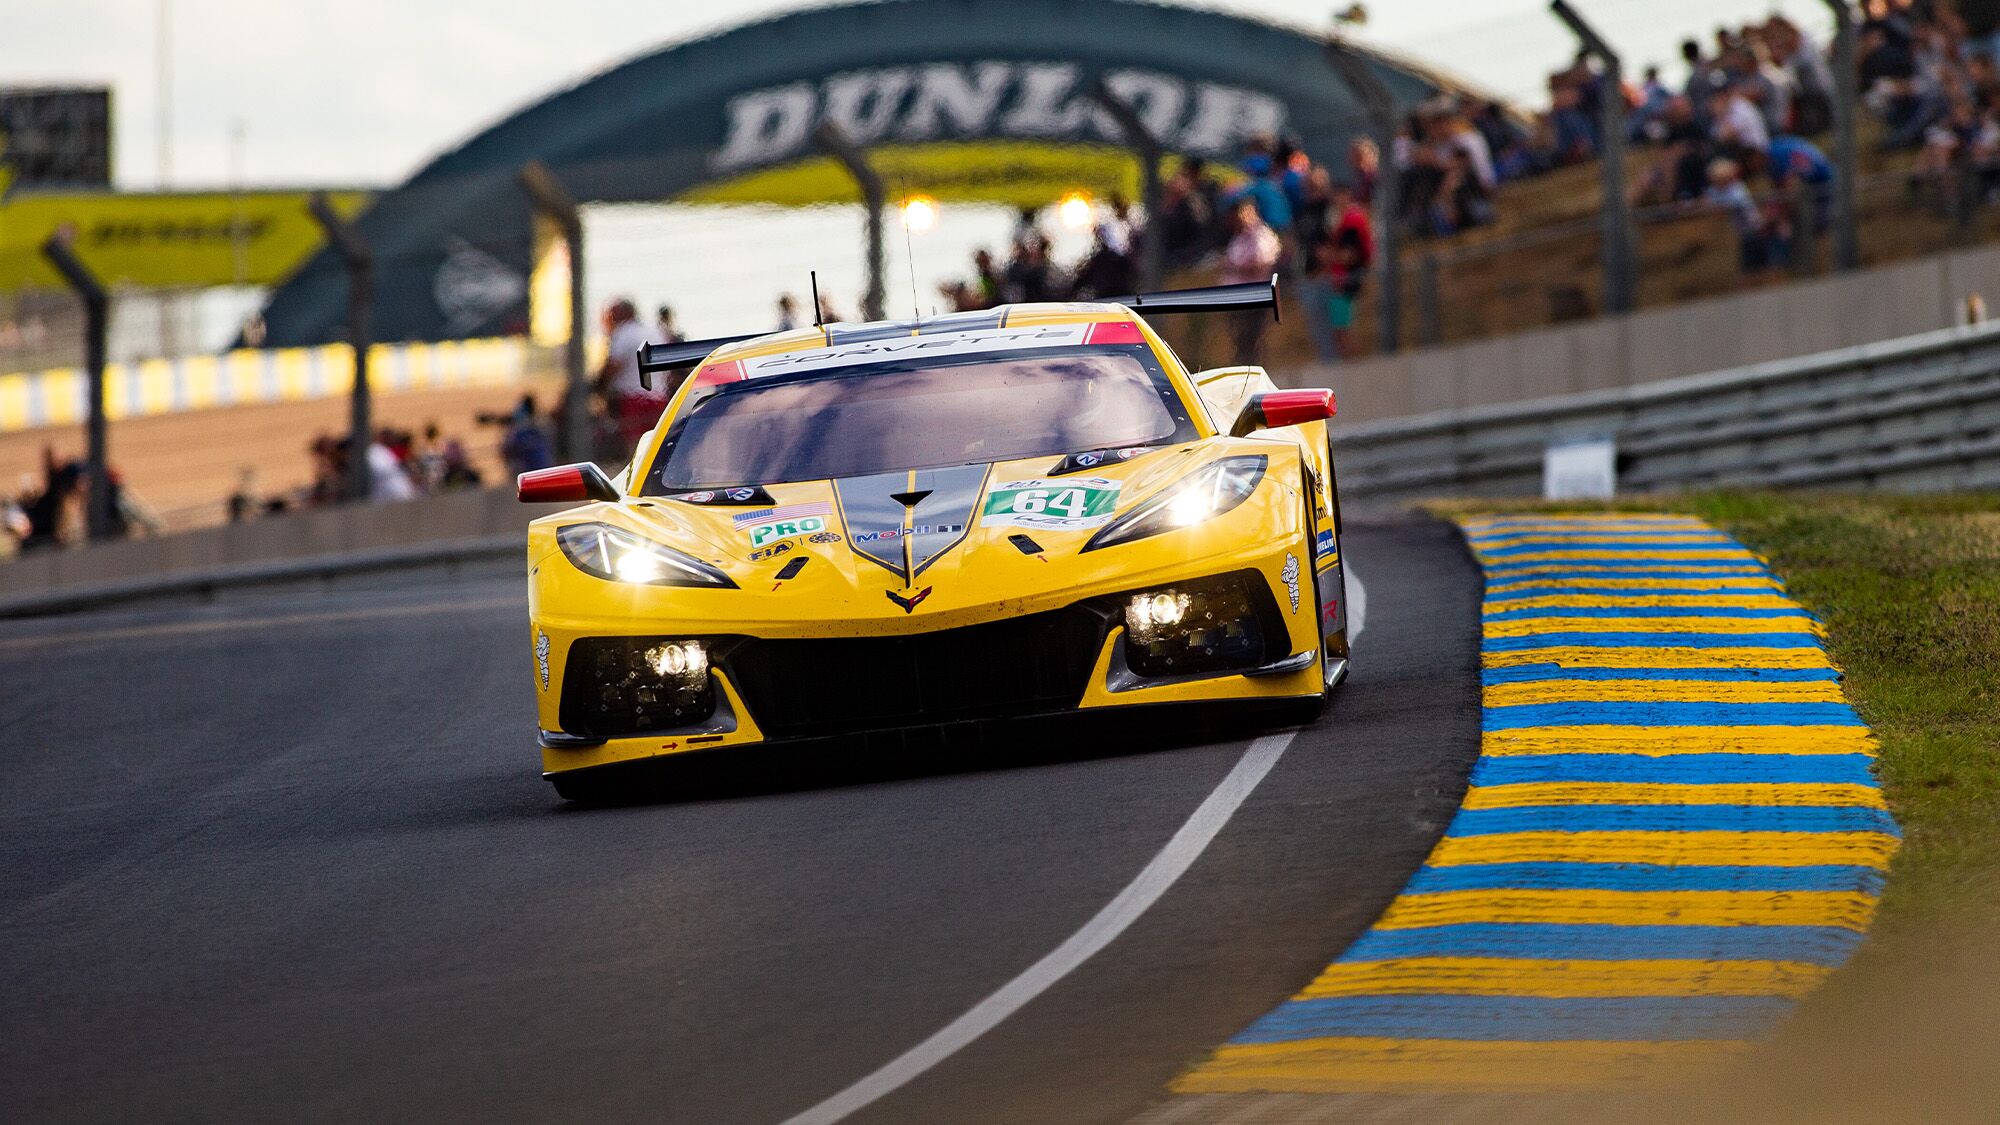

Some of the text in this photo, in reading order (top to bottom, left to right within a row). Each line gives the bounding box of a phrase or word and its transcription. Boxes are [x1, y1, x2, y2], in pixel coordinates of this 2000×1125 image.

[705, 61, 1288, 172] DUNLOP
[757, 330, 1074, 369] CORVETTE
[1012, 489, 1088, 517] 64
[754, 518, 821, 545] PRO
[856, 522, 931, 543] Mobil
[751, 543, 789, 560] FIA
